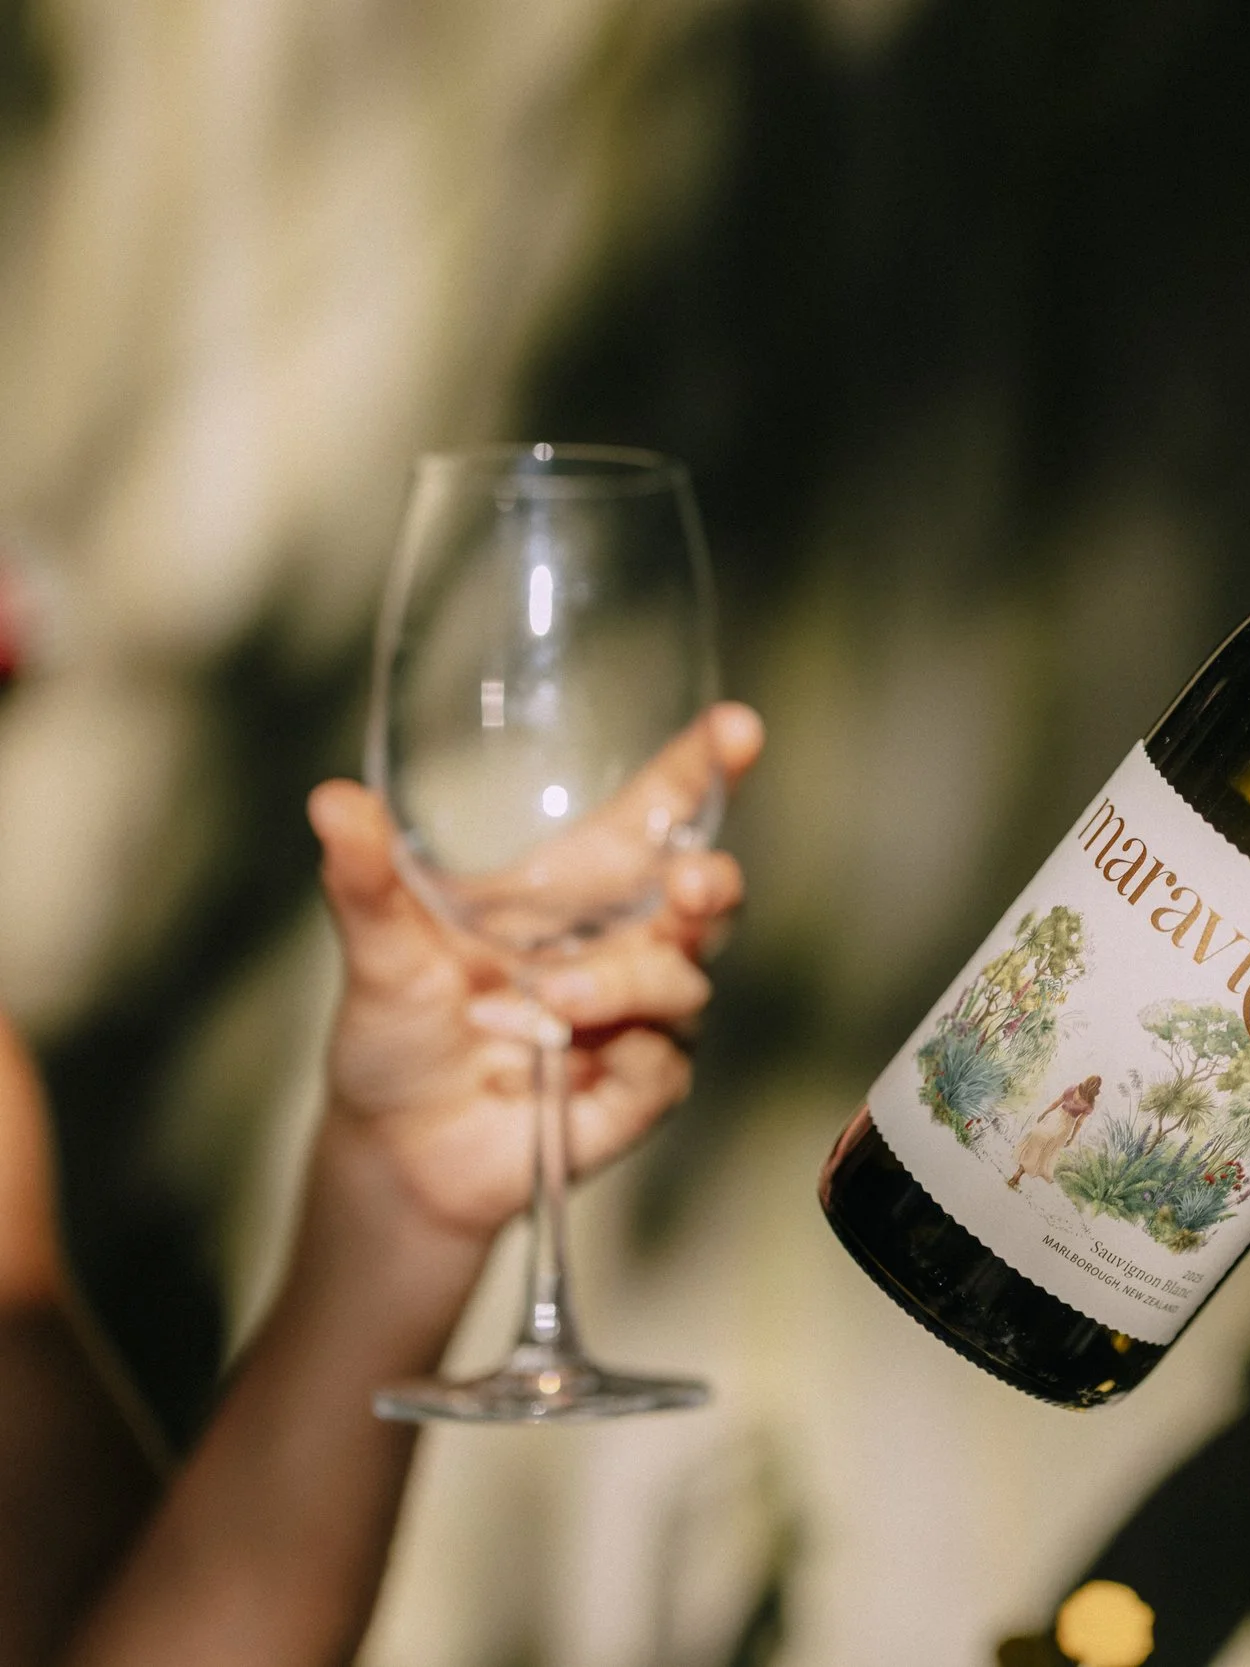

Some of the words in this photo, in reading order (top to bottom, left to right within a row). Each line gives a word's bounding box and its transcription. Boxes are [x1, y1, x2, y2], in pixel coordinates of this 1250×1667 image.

[1042, 1235, 1120, 1291] MARLBOROUGH,
[1122, 1285, 1146, 1301] NEW
[1090, 1240, 1161, 1287] Sauvignon
[1160, 1279, 1193, 1299] Blanc
